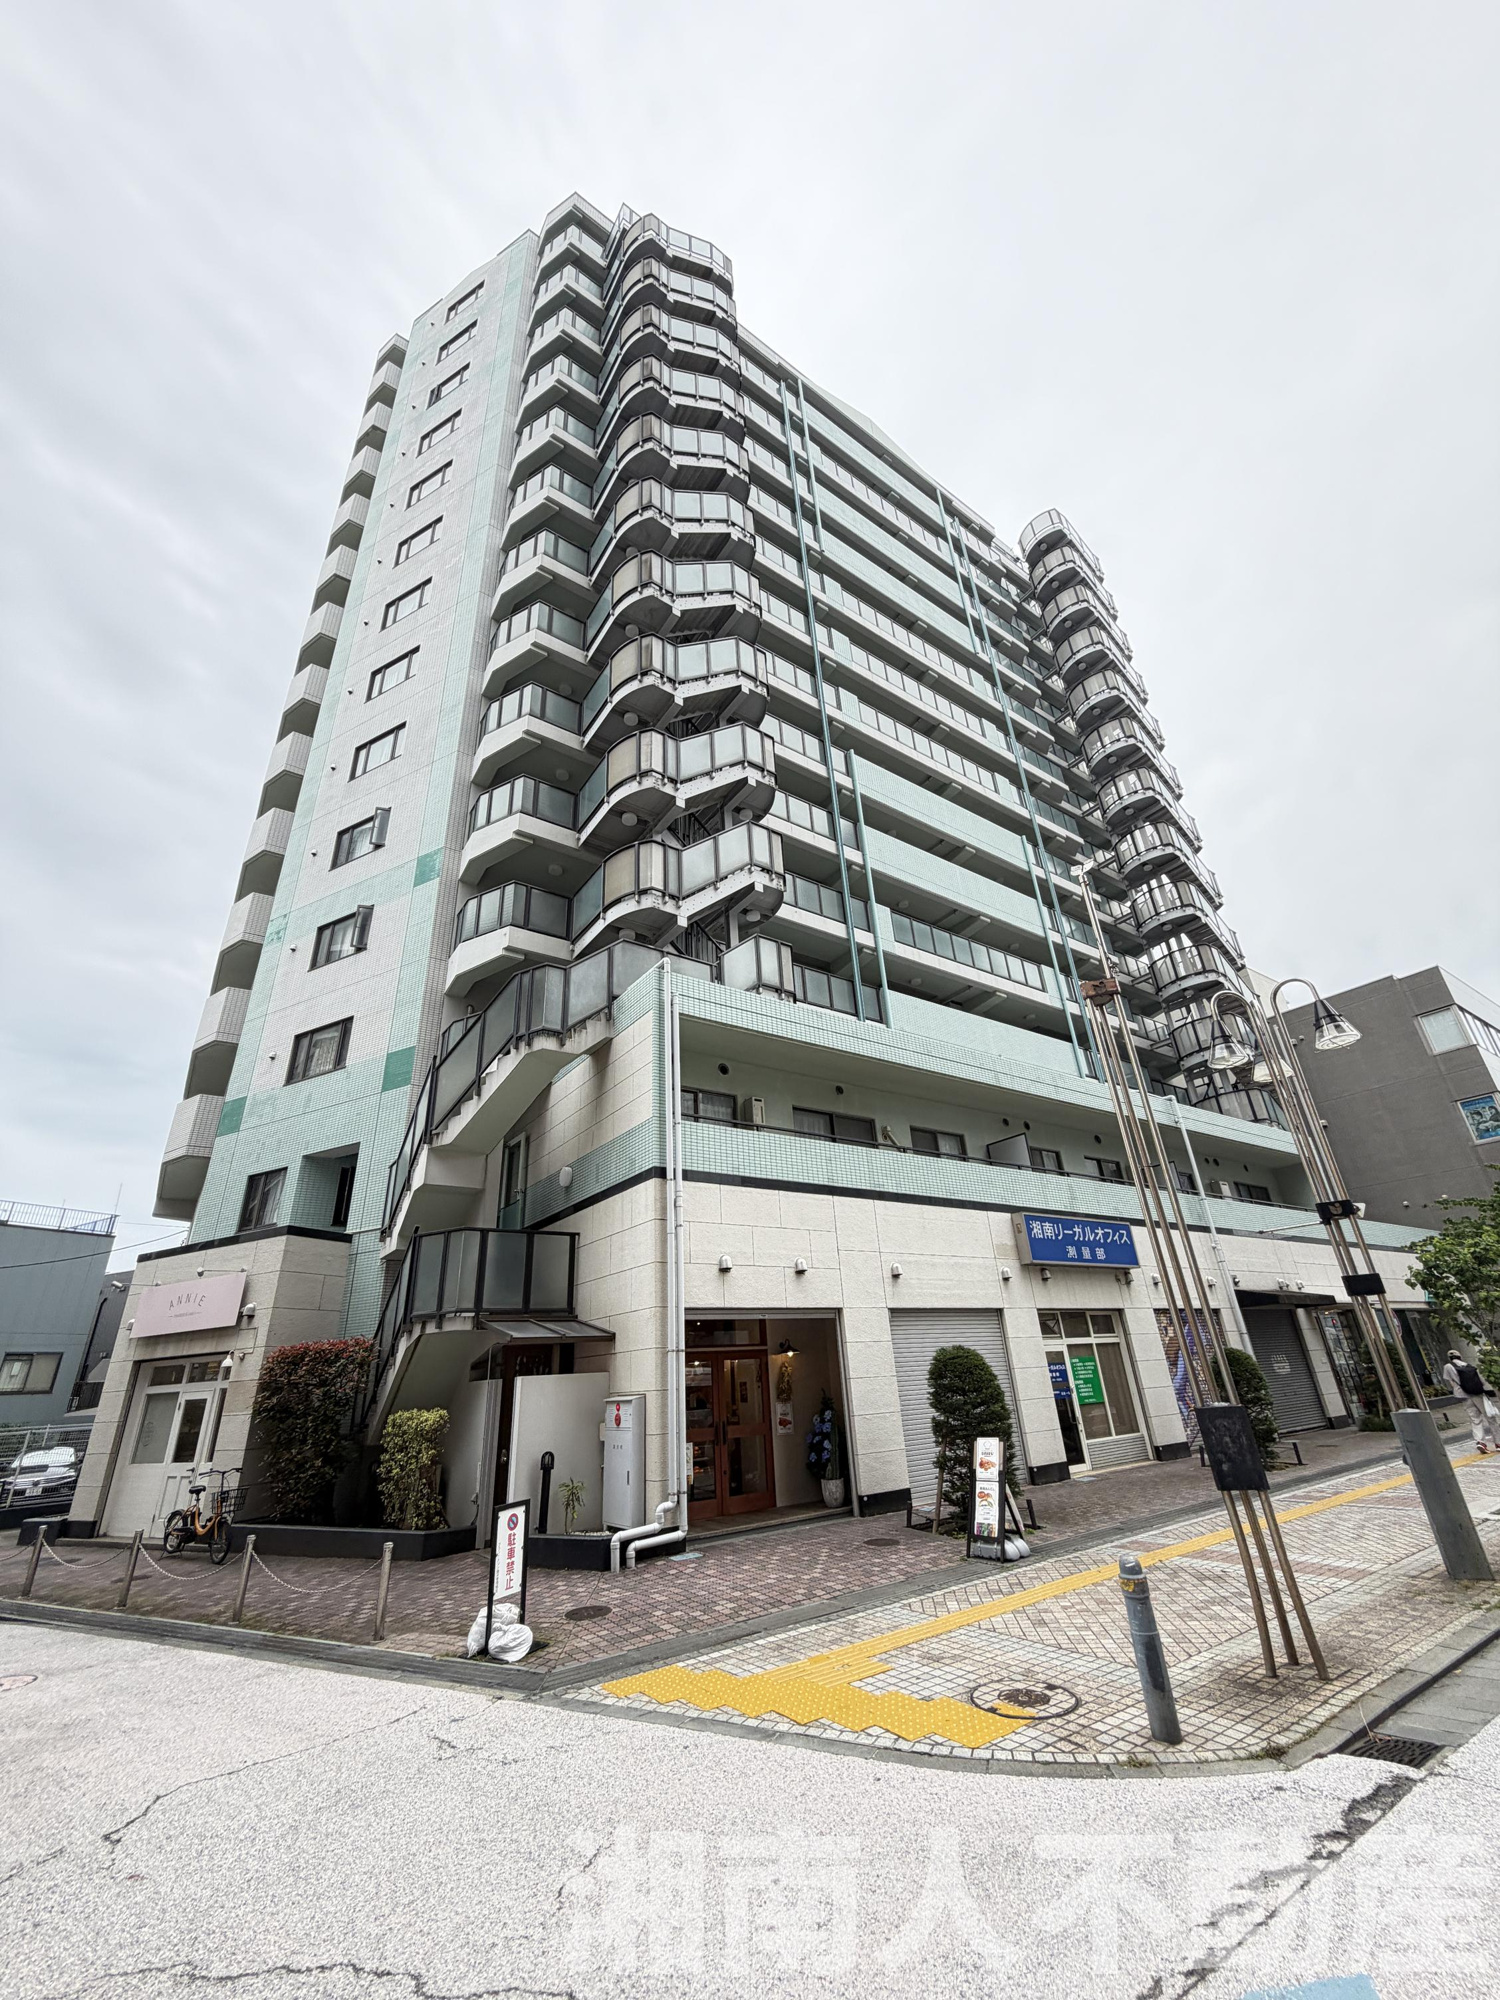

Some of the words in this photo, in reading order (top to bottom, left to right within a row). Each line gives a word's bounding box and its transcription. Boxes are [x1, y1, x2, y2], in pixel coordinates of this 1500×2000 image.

[1029, 1220, 1131, 1245] 湘南リーガルオフィス
[1066, 1245, 1107, 1260] 測量部
[168, 1292, 206, 1311] ANNIE
[505, 1532, 516, 1591] 駐車禁止
